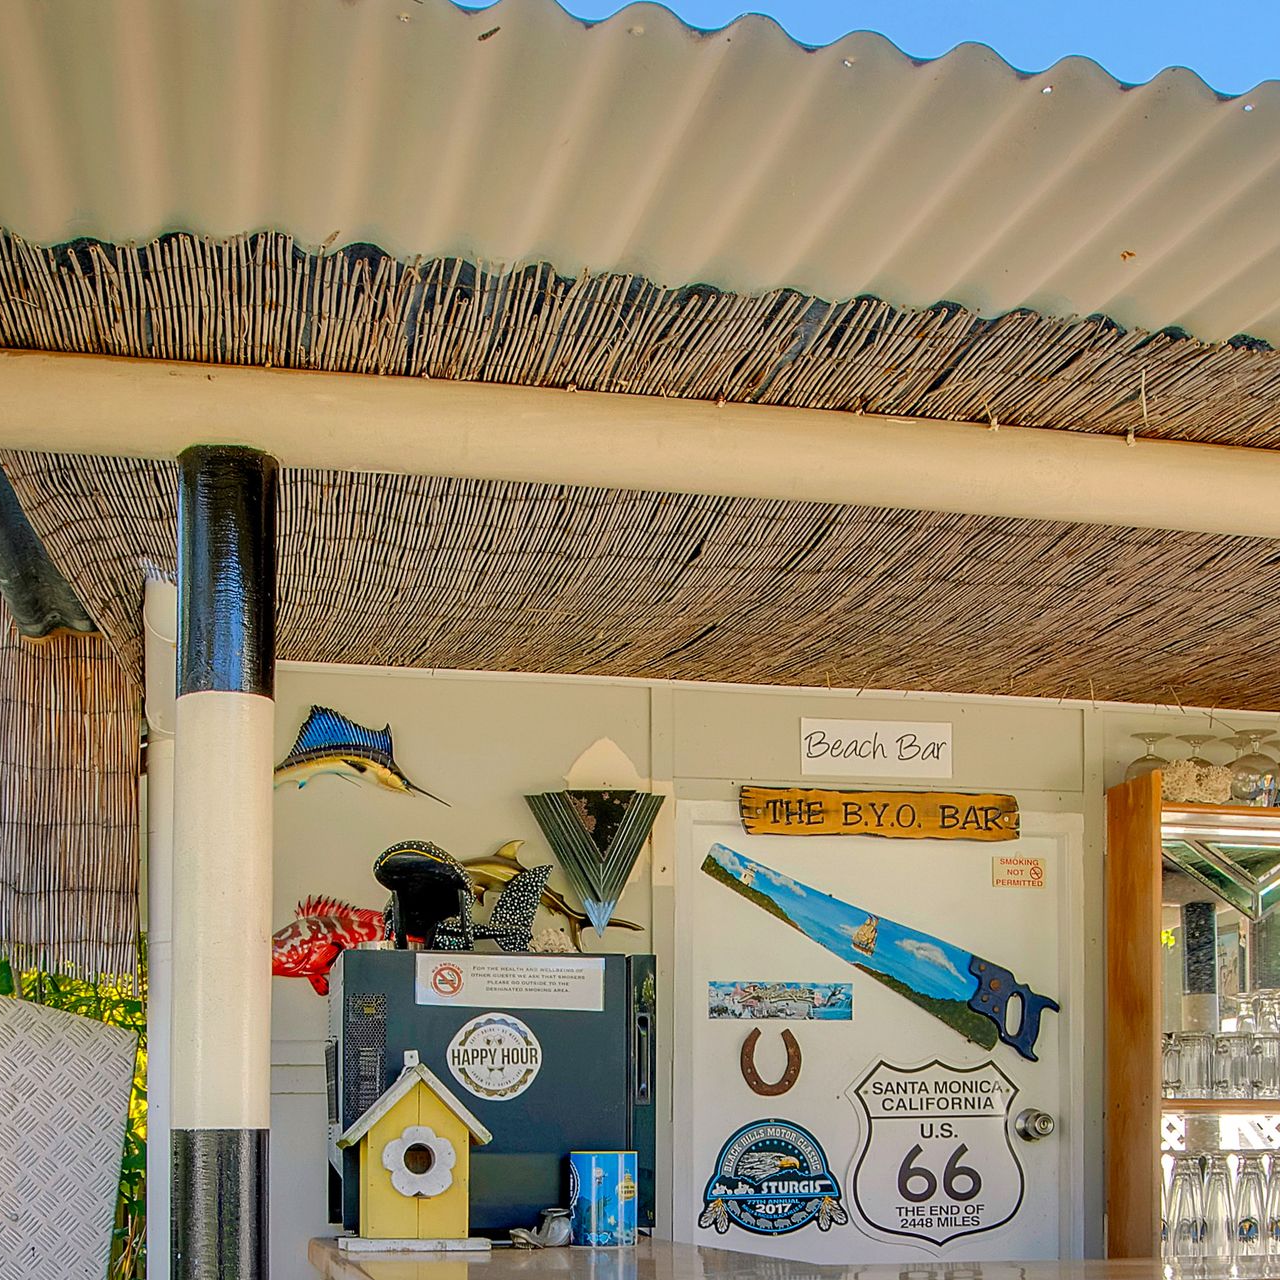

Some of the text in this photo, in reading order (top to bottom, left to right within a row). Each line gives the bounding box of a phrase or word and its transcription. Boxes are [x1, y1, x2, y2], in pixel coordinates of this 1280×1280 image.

[804, 730, 947, 761] Beach Bar
[766, 799, 1004, 832] THE B.Y.O. BAR
[996, 878, 1043, 887] PERMITTED
[452, 1047, 538, 1066] HAPPY HOUR
[872, 1080, 1003, 1095] SANTA MONICA
[882, 1097, 994, 1111] CALIFORNIA
[920, 1123, 958, 1139] U.S.
[724, 1128, 821, 1172] BLACK HILLS MOTOR CLASSIC
[897, 1143, 982, 1202] 66
[761, 1180, 832, 1194] STURGIS
[755, 1203, 792, 1214] 2017
[896, 1204, 984, 1217] THE END OF
[900, 1216, 980, 1229] 2448 MILES
